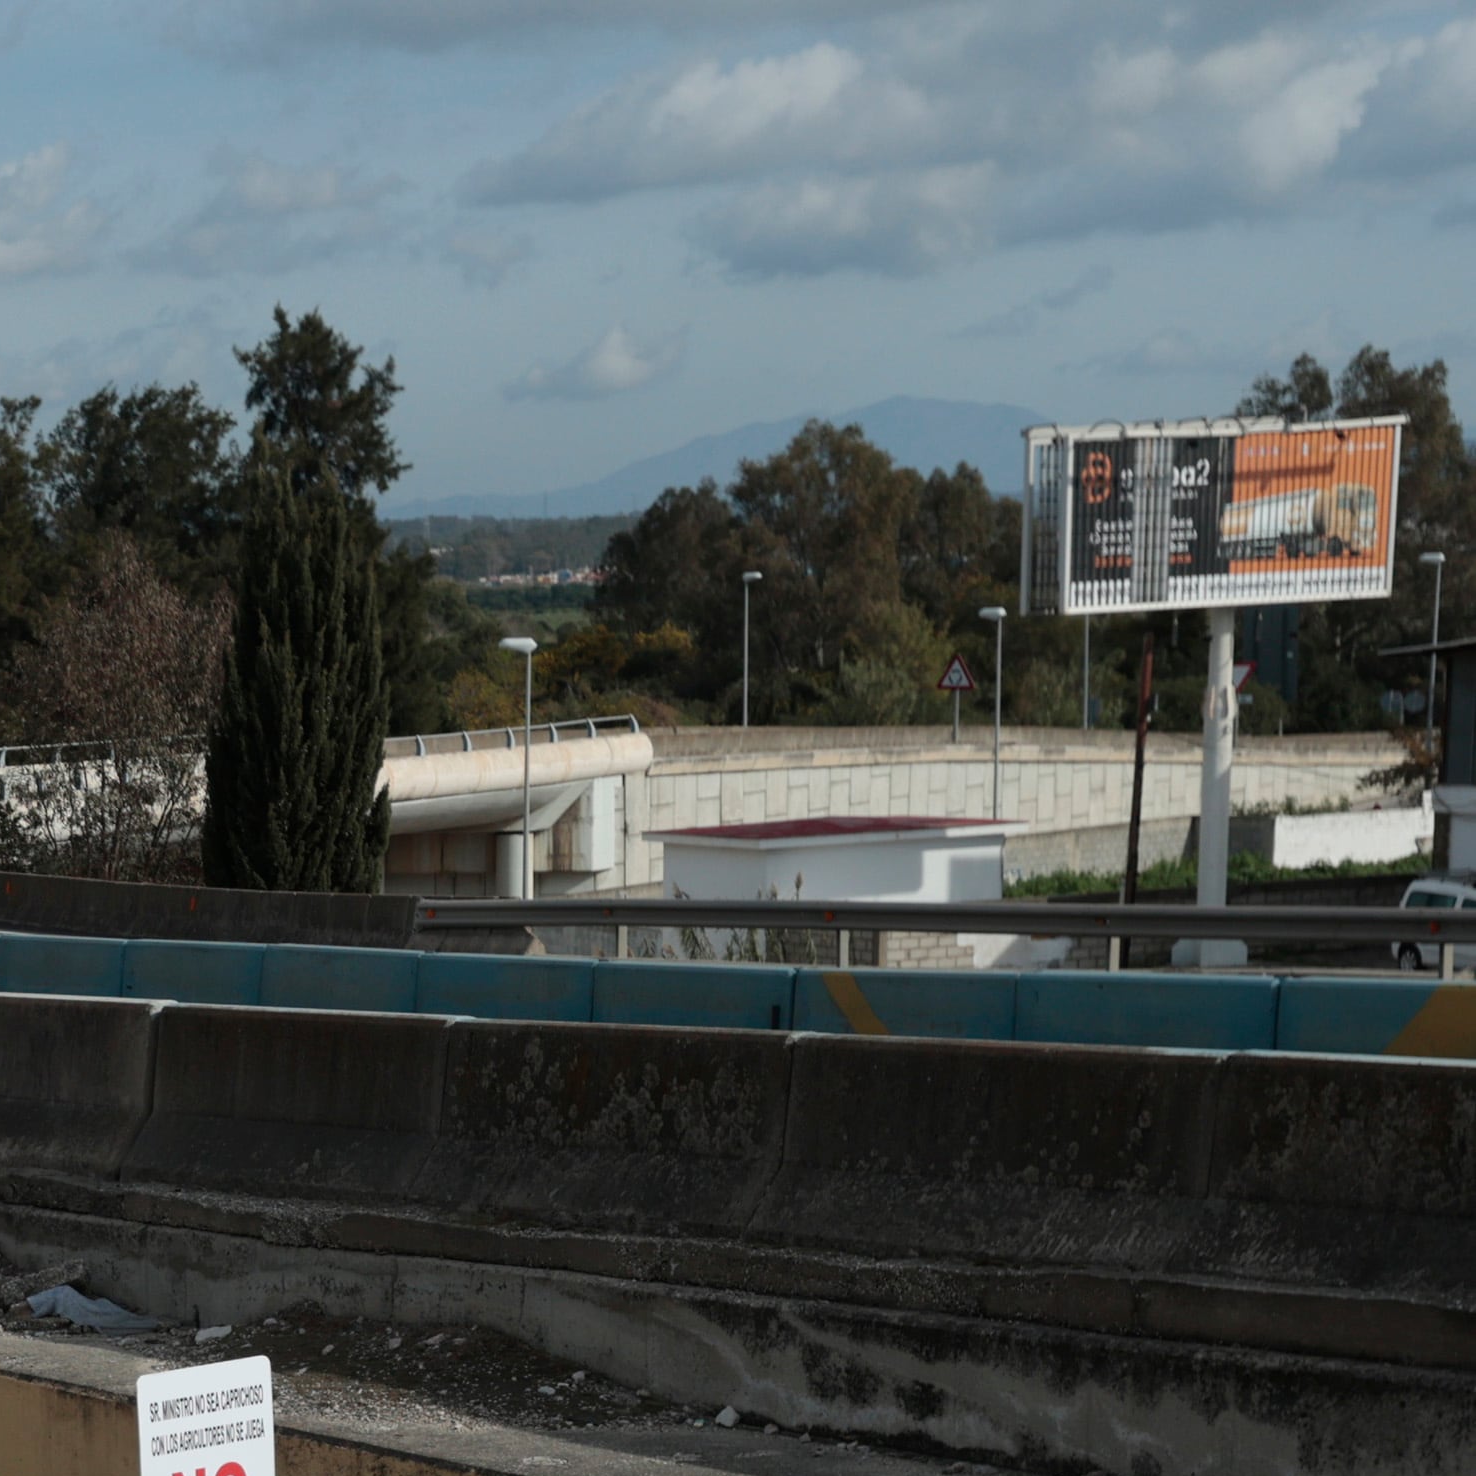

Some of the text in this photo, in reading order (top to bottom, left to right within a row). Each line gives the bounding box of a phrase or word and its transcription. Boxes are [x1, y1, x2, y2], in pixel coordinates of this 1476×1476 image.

[150, 1384, 264, 1422] SR. MINISTRO NO SEA CAPRICHOSO
[151, 1418, 265, 1456] CON LOS AGRICULTORES NO SE JUEGA
